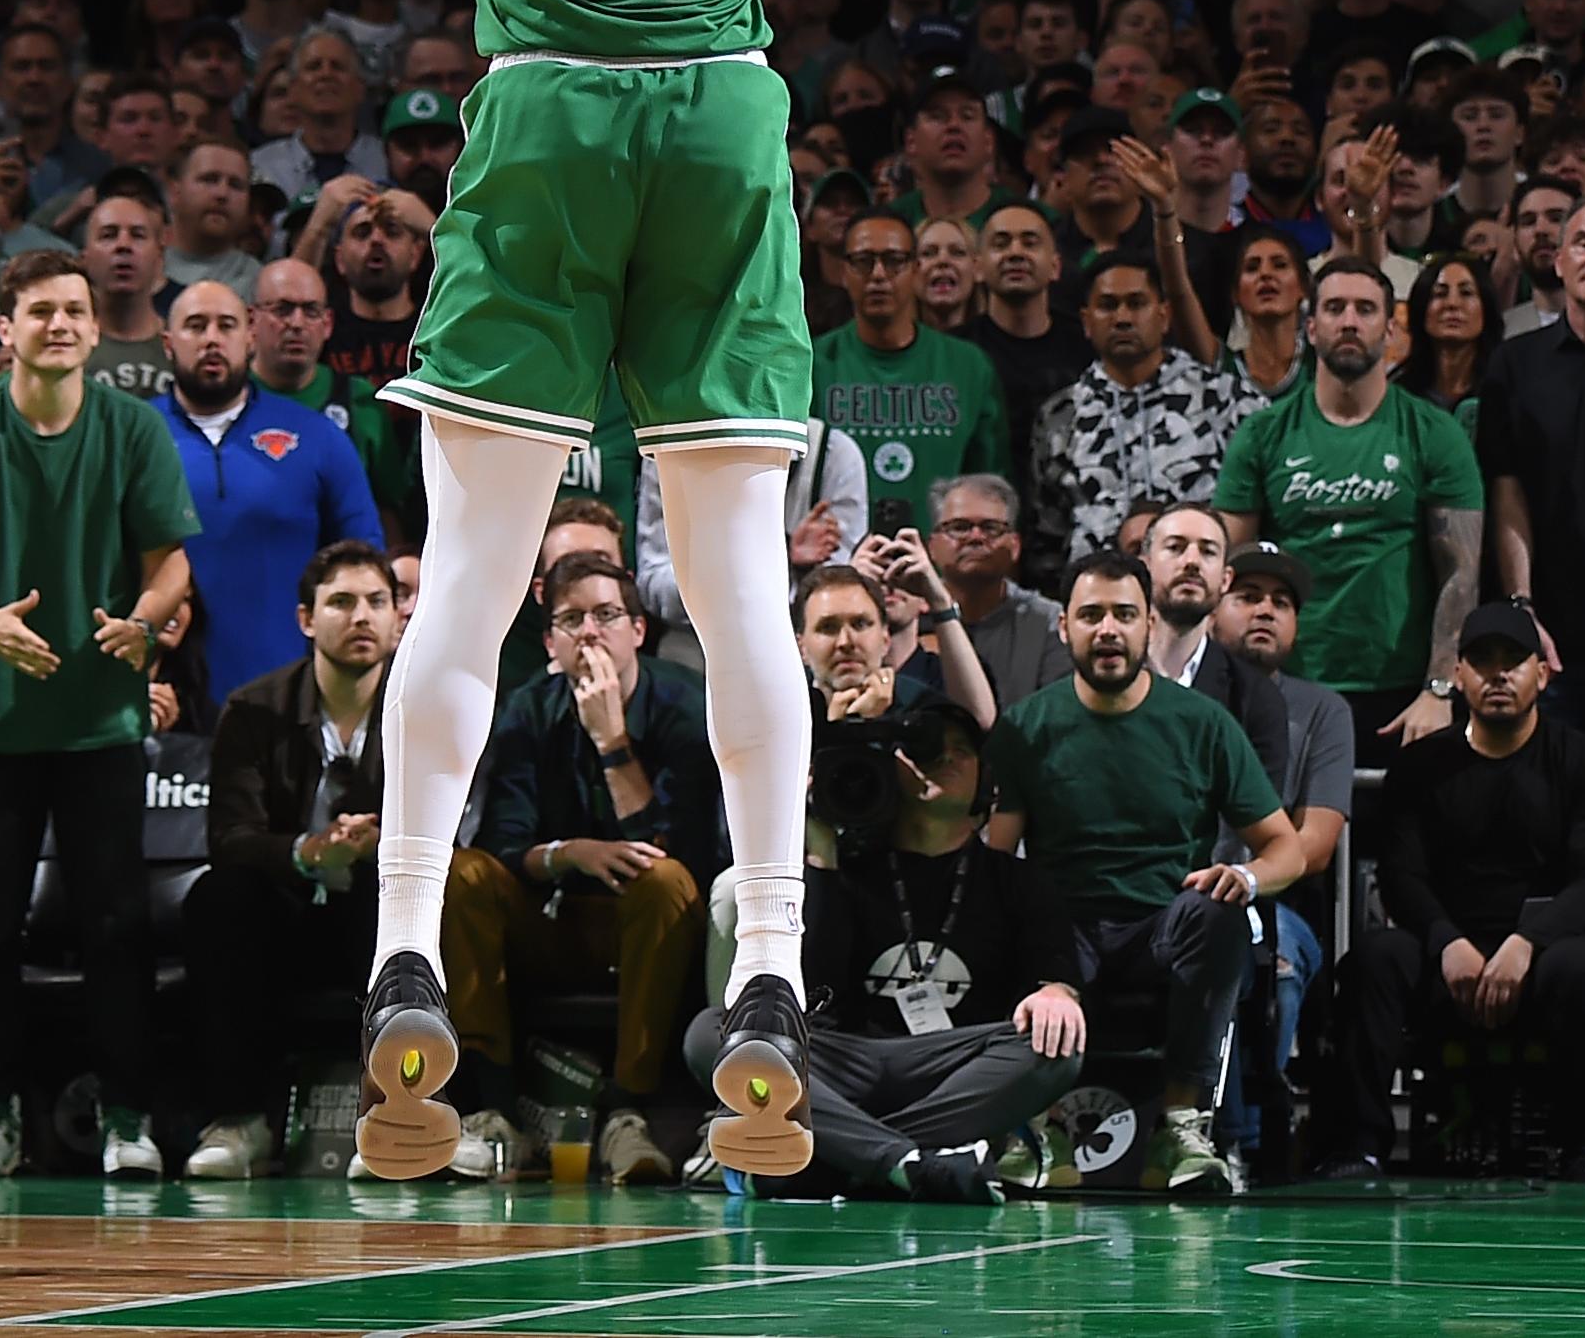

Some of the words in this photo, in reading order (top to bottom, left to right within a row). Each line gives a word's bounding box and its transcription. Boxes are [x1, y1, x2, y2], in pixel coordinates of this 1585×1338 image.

[826, 383, 961, 427] CELTICS
[1282, 471, 1401, 504] Boston
[145, 771, 211, 808] ltics
